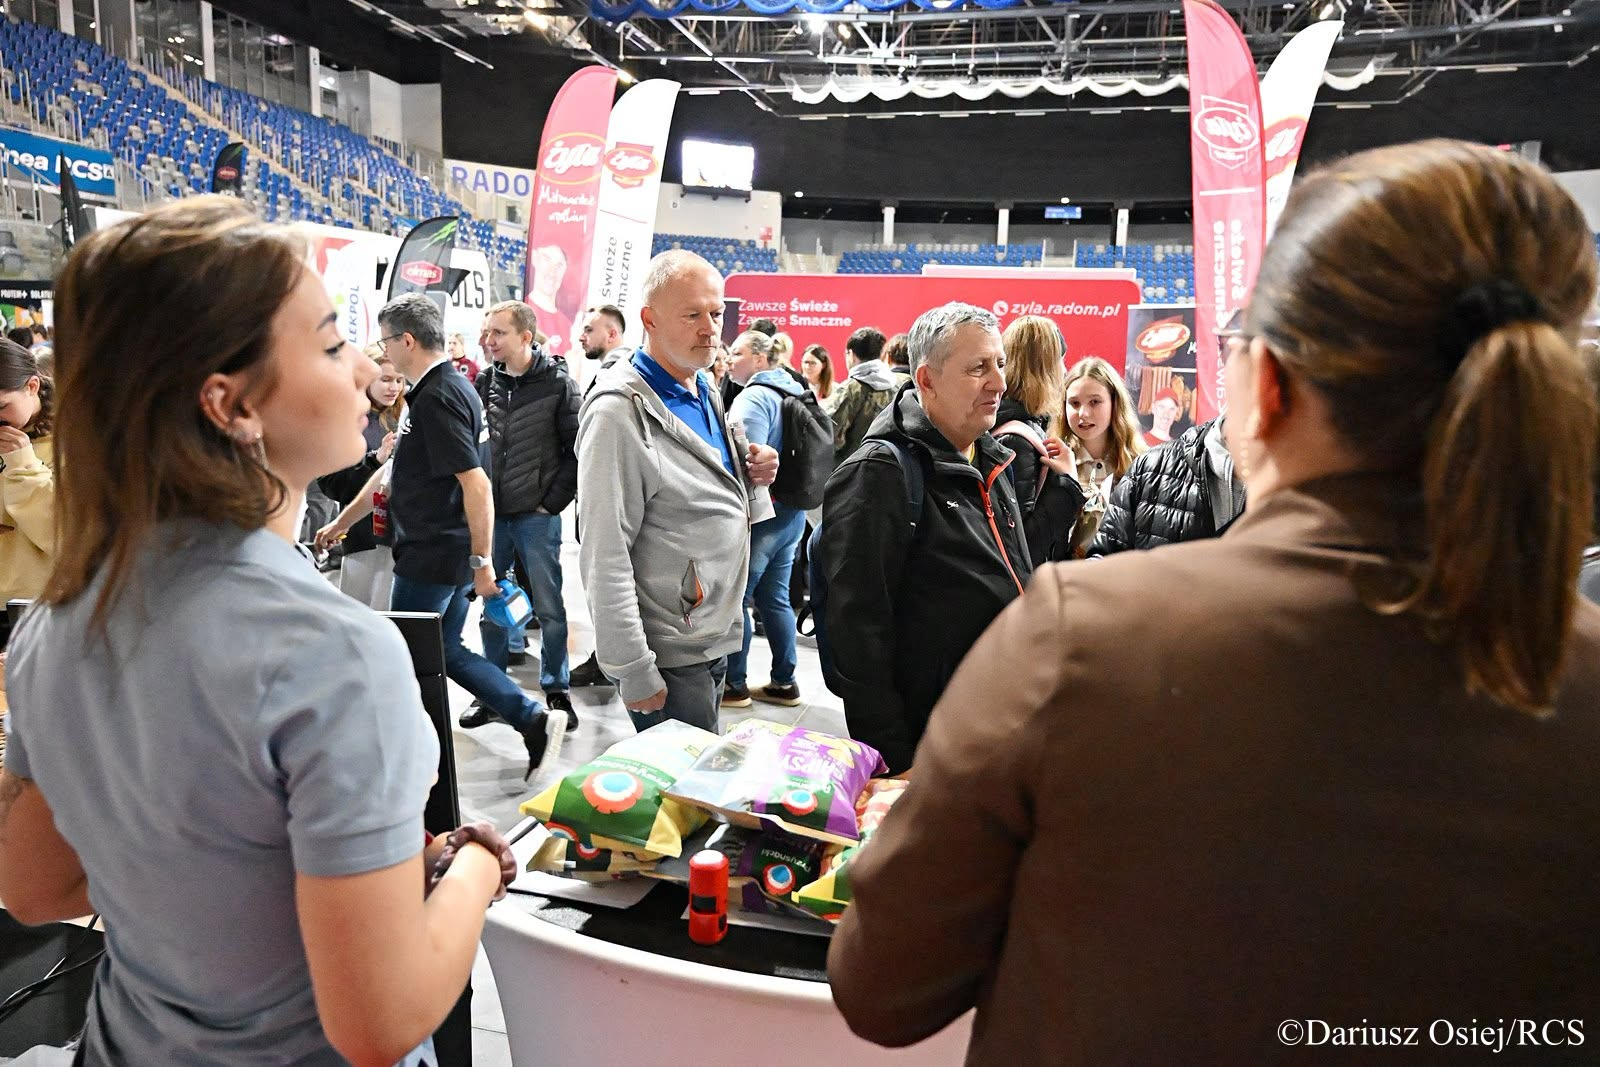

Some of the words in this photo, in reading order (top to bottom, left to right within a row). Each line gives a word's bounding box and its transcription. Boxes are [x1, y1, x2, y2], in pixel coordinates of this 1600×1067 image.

[0, 142, 49, 172] nea
[616, 240, 633, 309] maczne
[738, 300, 787, 312] Zawsze
[789, 298, 839, 313] Świeże
[1010, 301, 1121, 318] zyla.radom.pl
[789, 314, 852, 327] Smaczne
